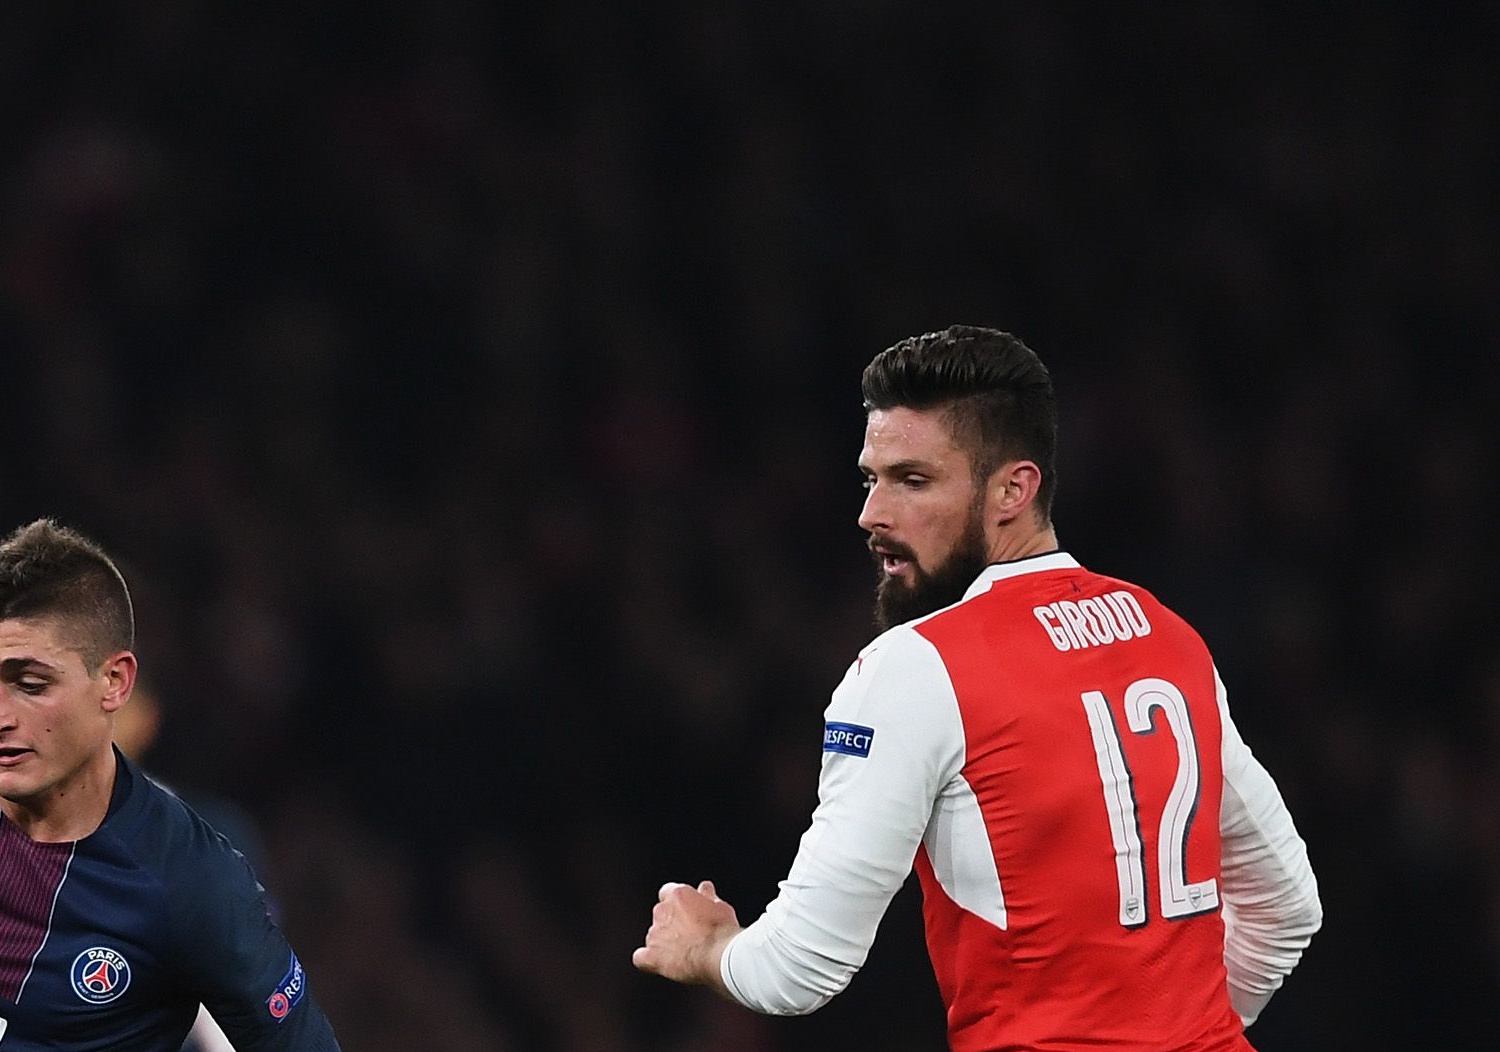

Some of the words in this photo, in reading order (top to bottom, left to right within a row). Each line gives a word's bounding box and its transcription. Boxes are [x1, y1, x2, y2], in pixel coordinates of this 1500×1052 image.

[1033, 590, 1151, 652] GIROUD
[1080, 677, 1220, 929] 12
[87, 950, 125, 970] PARIS
